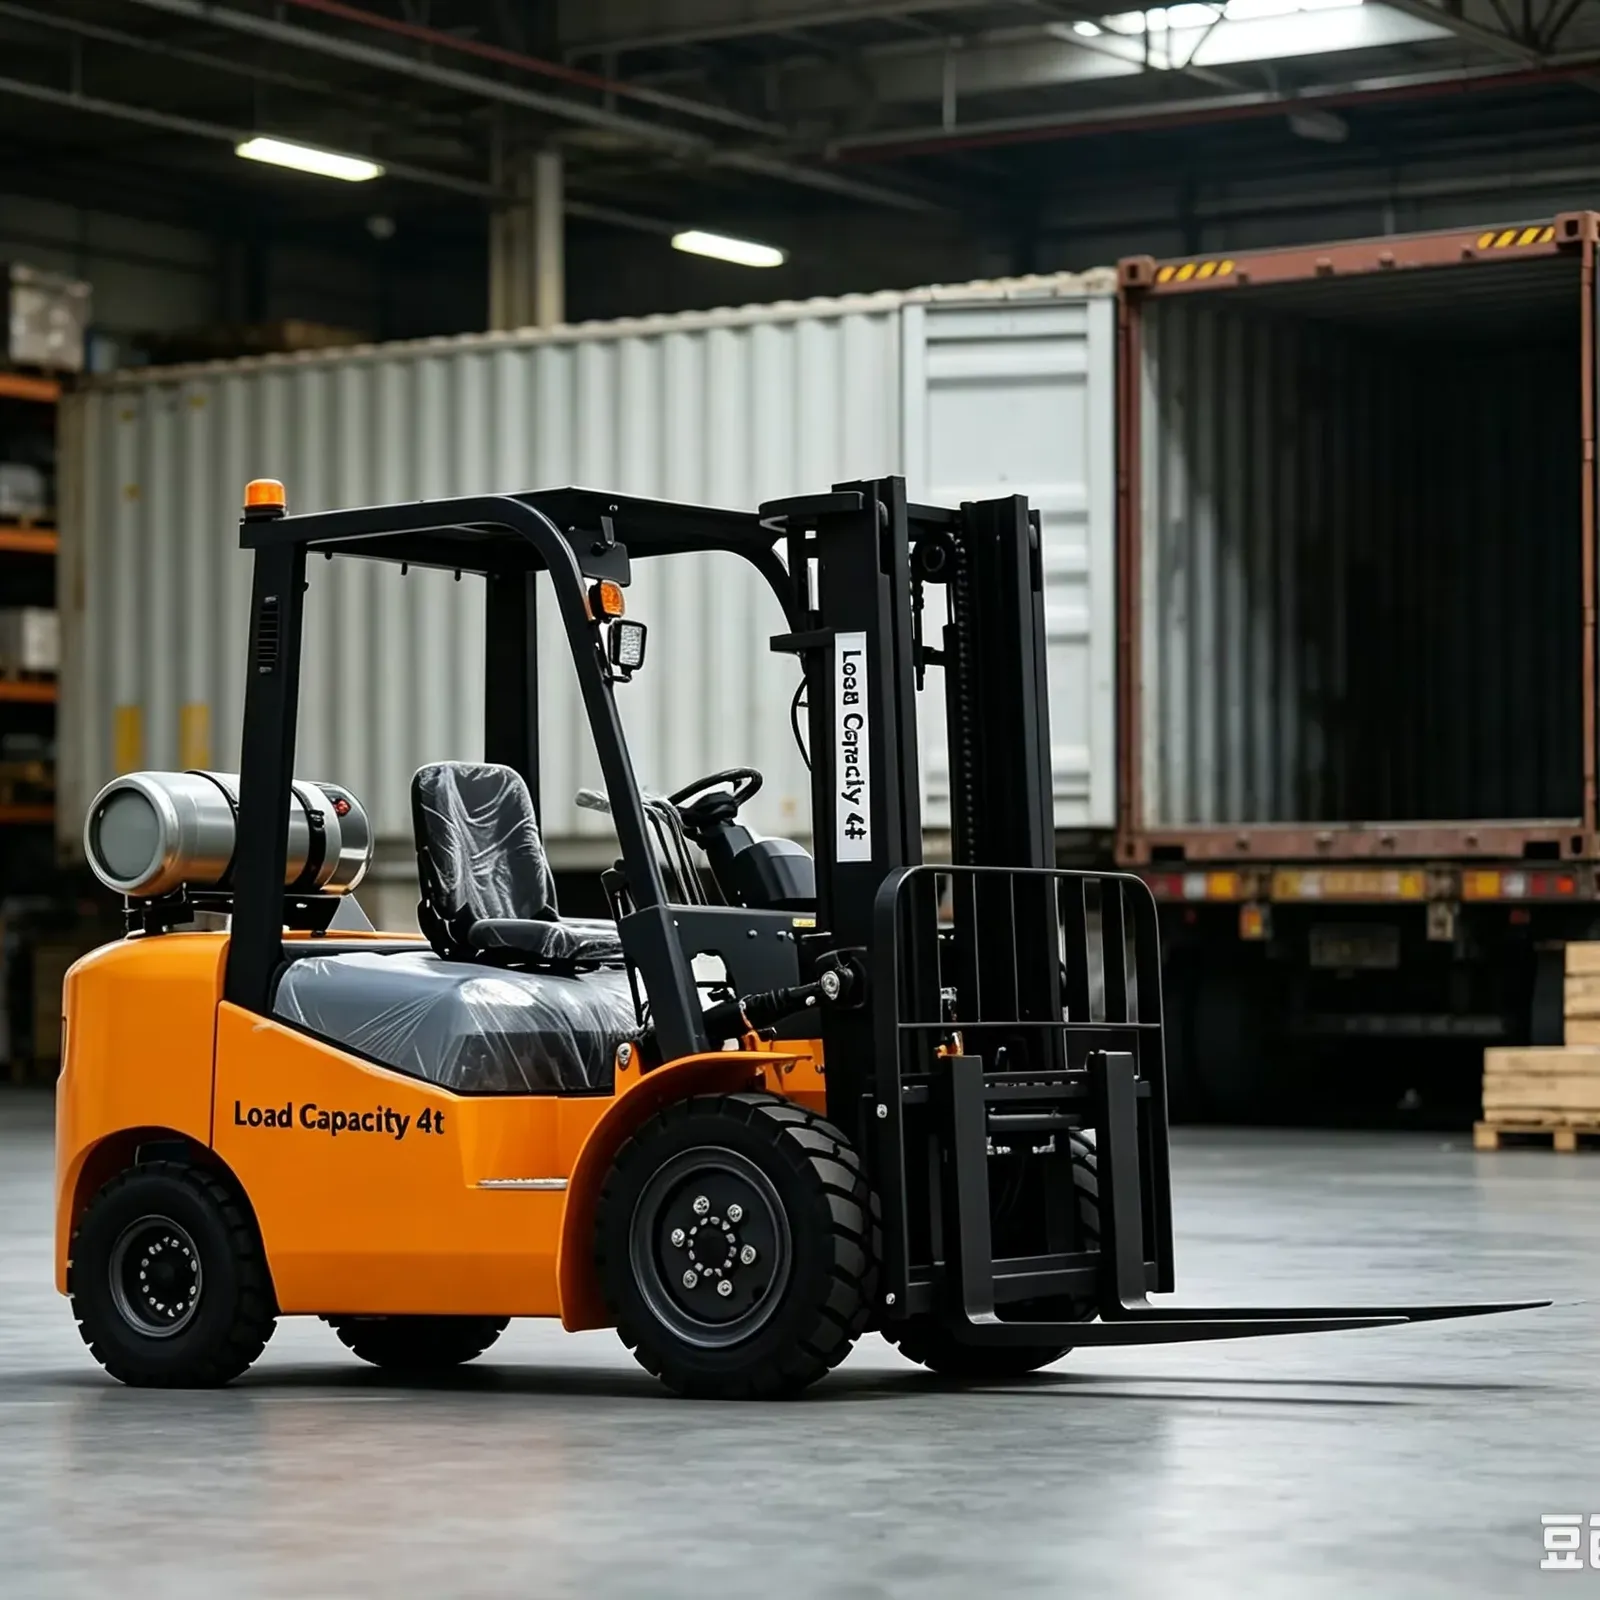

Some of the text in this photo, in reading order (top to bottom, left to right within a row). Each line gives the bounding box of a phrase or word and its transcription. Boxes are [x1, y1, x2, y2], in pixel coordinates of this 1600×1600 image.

[234, 1100, 445, 1141] Load Capacity 4t
